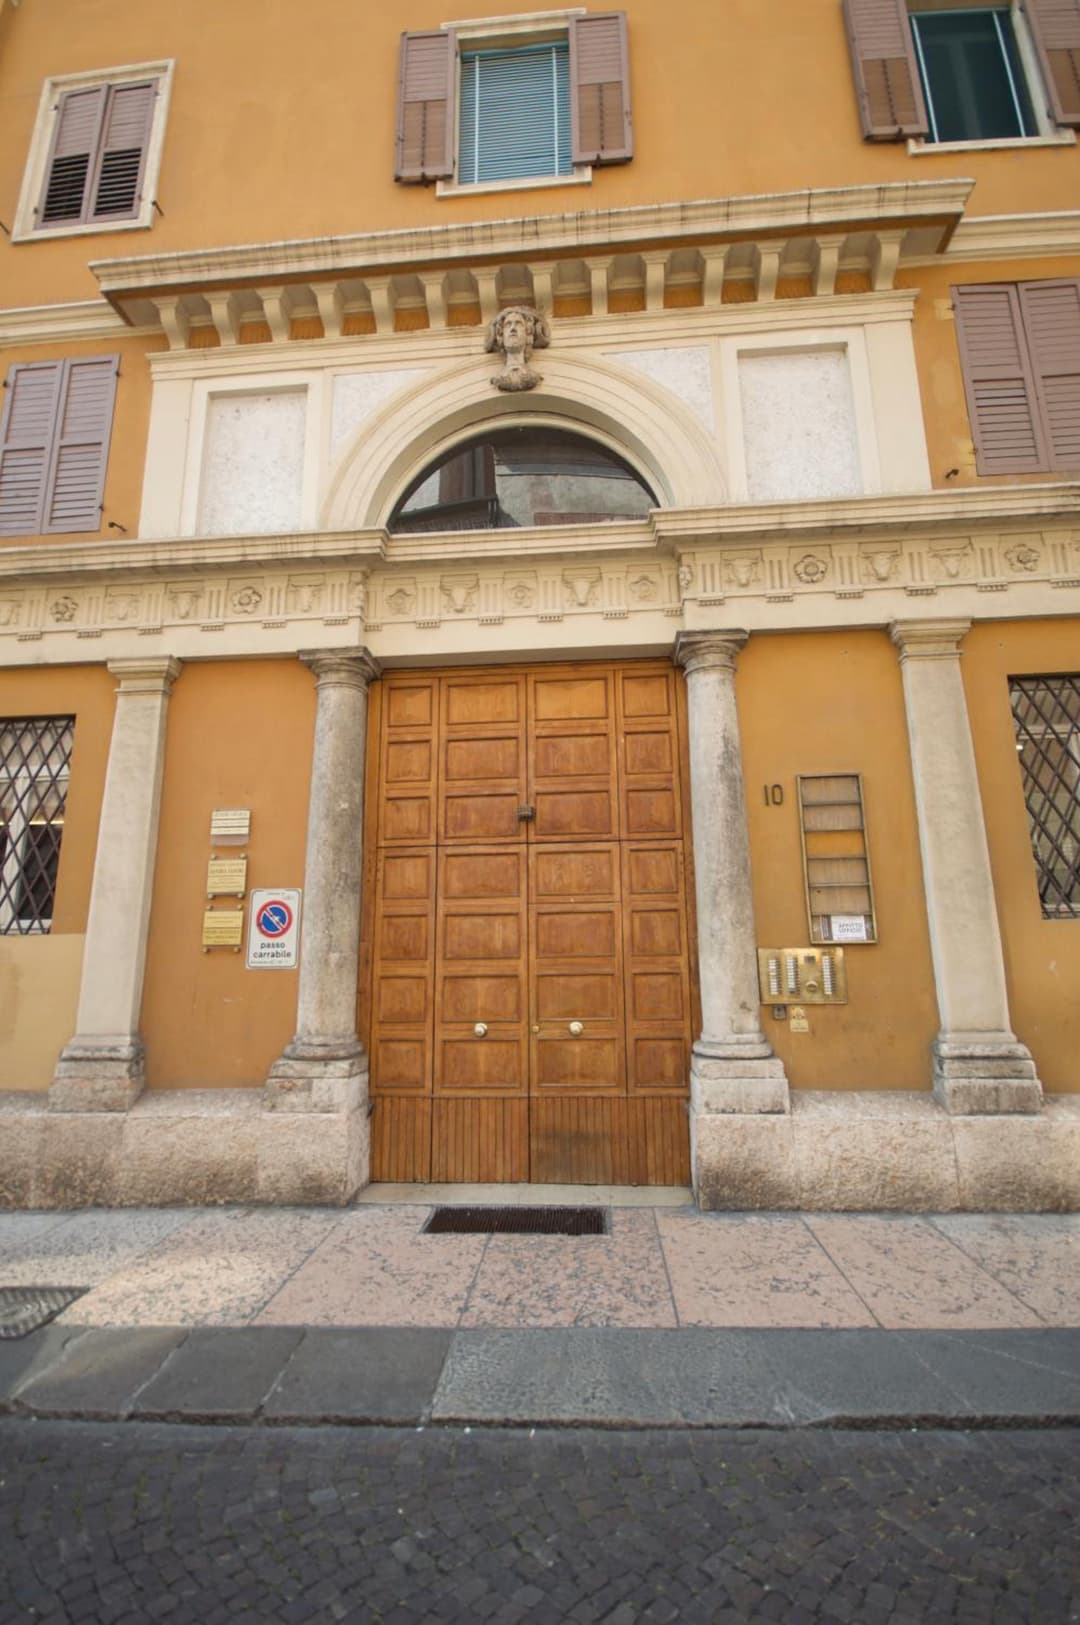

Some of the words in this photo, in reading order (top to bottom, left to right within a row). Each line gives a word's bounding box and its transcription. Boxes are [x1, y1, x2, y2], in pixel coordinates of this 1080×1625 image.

[763, 784, 784, 806] 10
[260, 942, 286, 950] passo
[253, 950, 292, 959] carrabile
